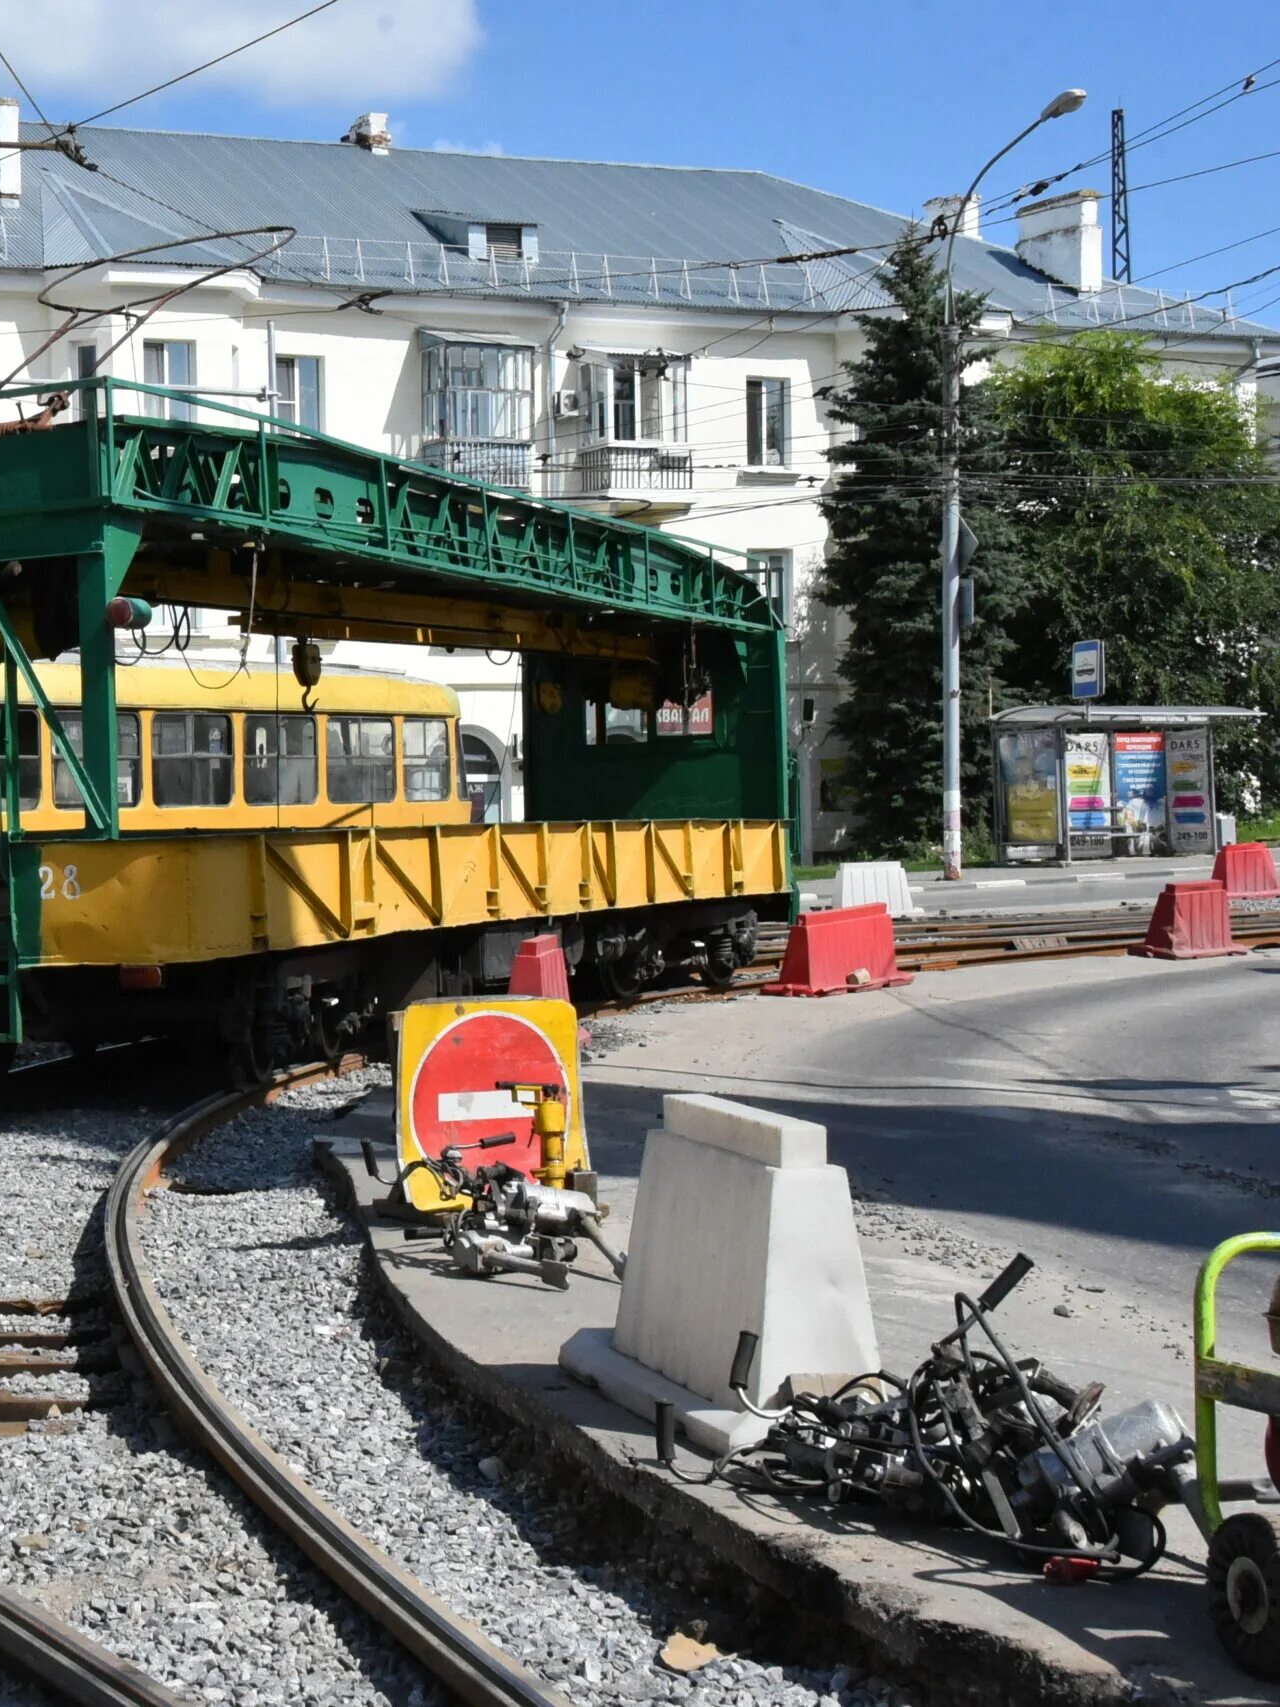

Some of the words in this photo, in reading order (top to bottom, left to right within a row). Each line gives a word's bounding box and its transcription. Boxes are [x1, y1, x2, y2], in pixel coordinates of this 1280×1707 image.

[1065, 741, 1099, 752] DARS
[1170, 740, 1200, 750] DARS
[1176, 831, 1208, 841] 249-100
[38, 864, 81, 900] 28
